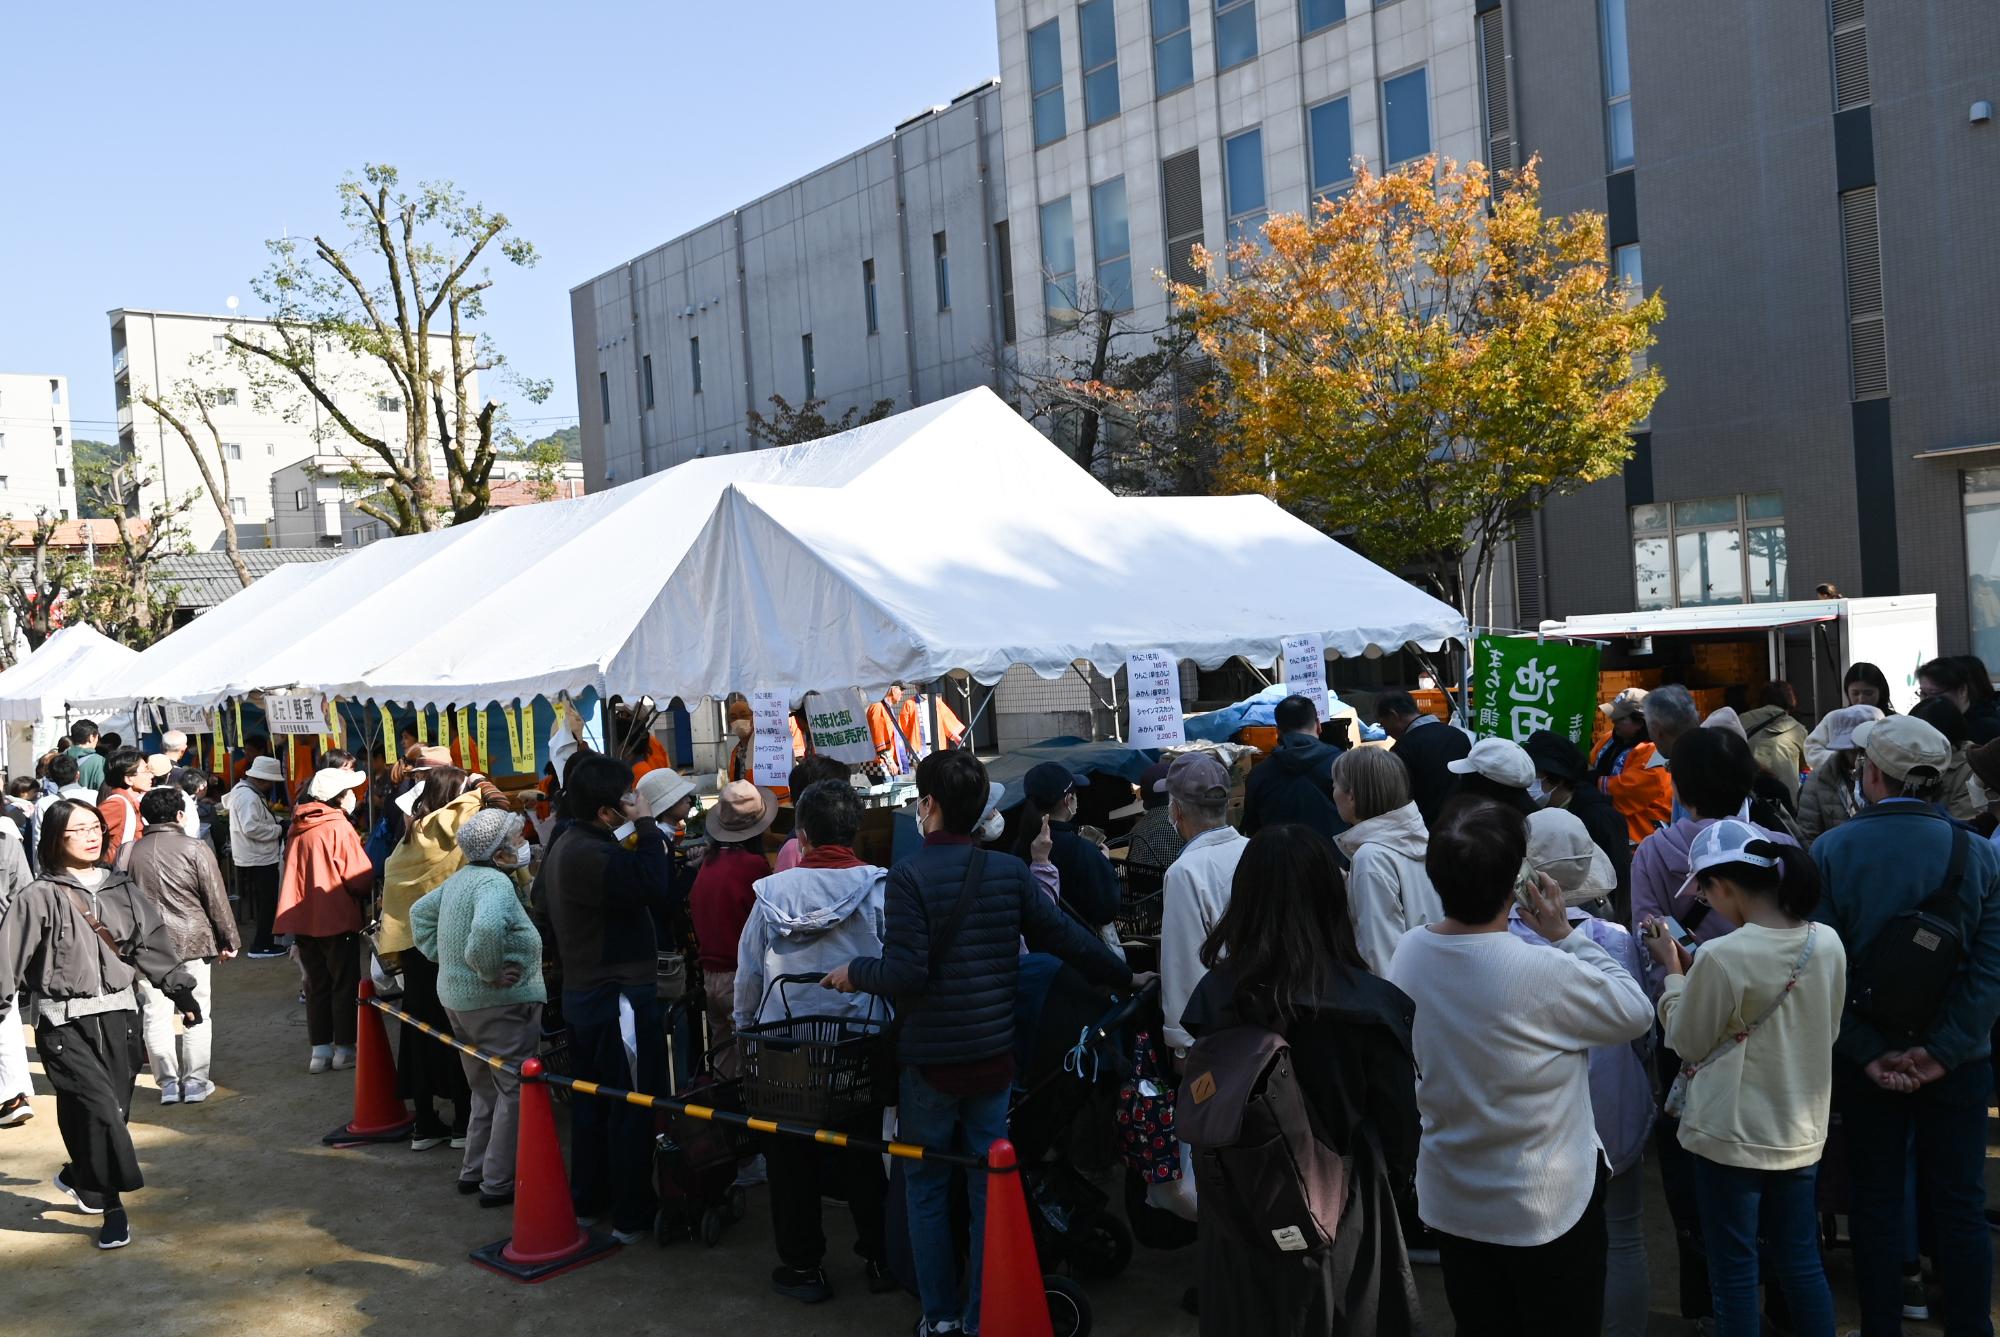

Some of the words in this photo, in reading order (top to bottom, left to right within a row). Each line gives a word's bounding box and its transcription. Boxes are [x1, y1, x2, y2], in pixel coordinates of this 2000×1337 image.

[1137, 706, 1175, 716] シャインマスカット
